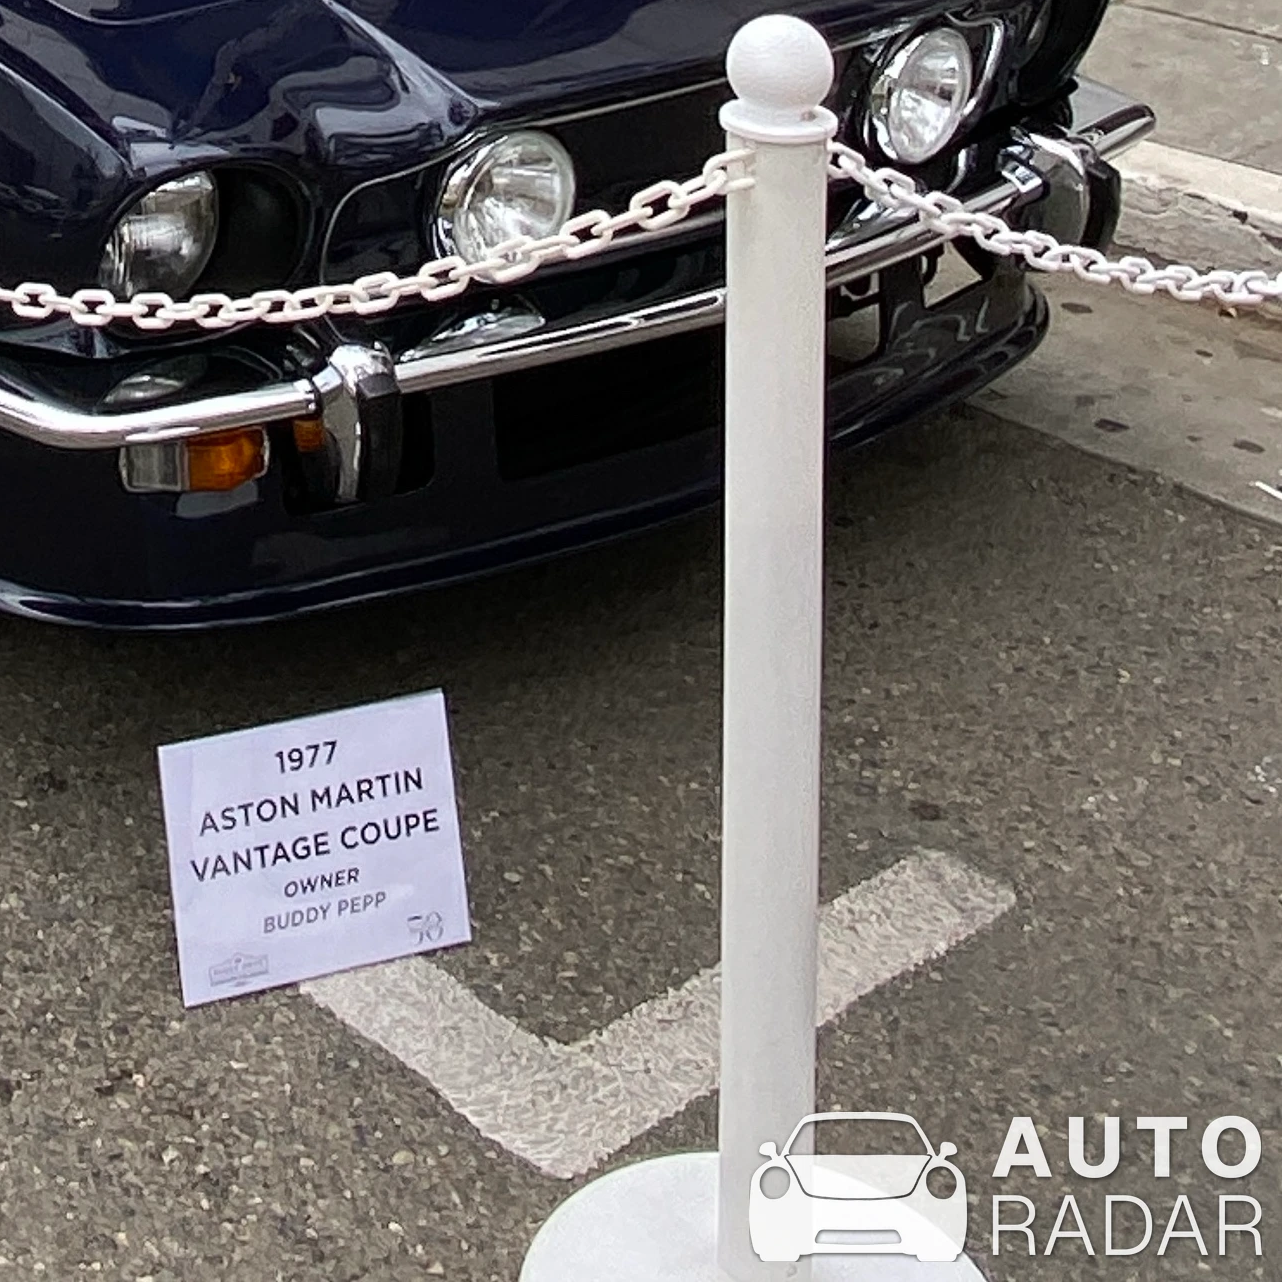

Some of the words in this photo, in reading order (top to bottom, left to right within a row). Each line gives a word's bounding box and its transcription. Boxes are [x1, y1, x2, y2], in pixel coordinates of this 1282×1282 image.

[275, 740, 338, 774] 1977
[199, 792, 300, 837] ASTON
[310, 767, 424, 813] MARTIN
[190, 832, 331, 882] VANTAGE
[340, 808, 440, 850] COUPE
[284, 867, 360, 898] OWNER
[263, 902, 331, 934] BUDDY
[337, 891, 387, 917] PEPP
